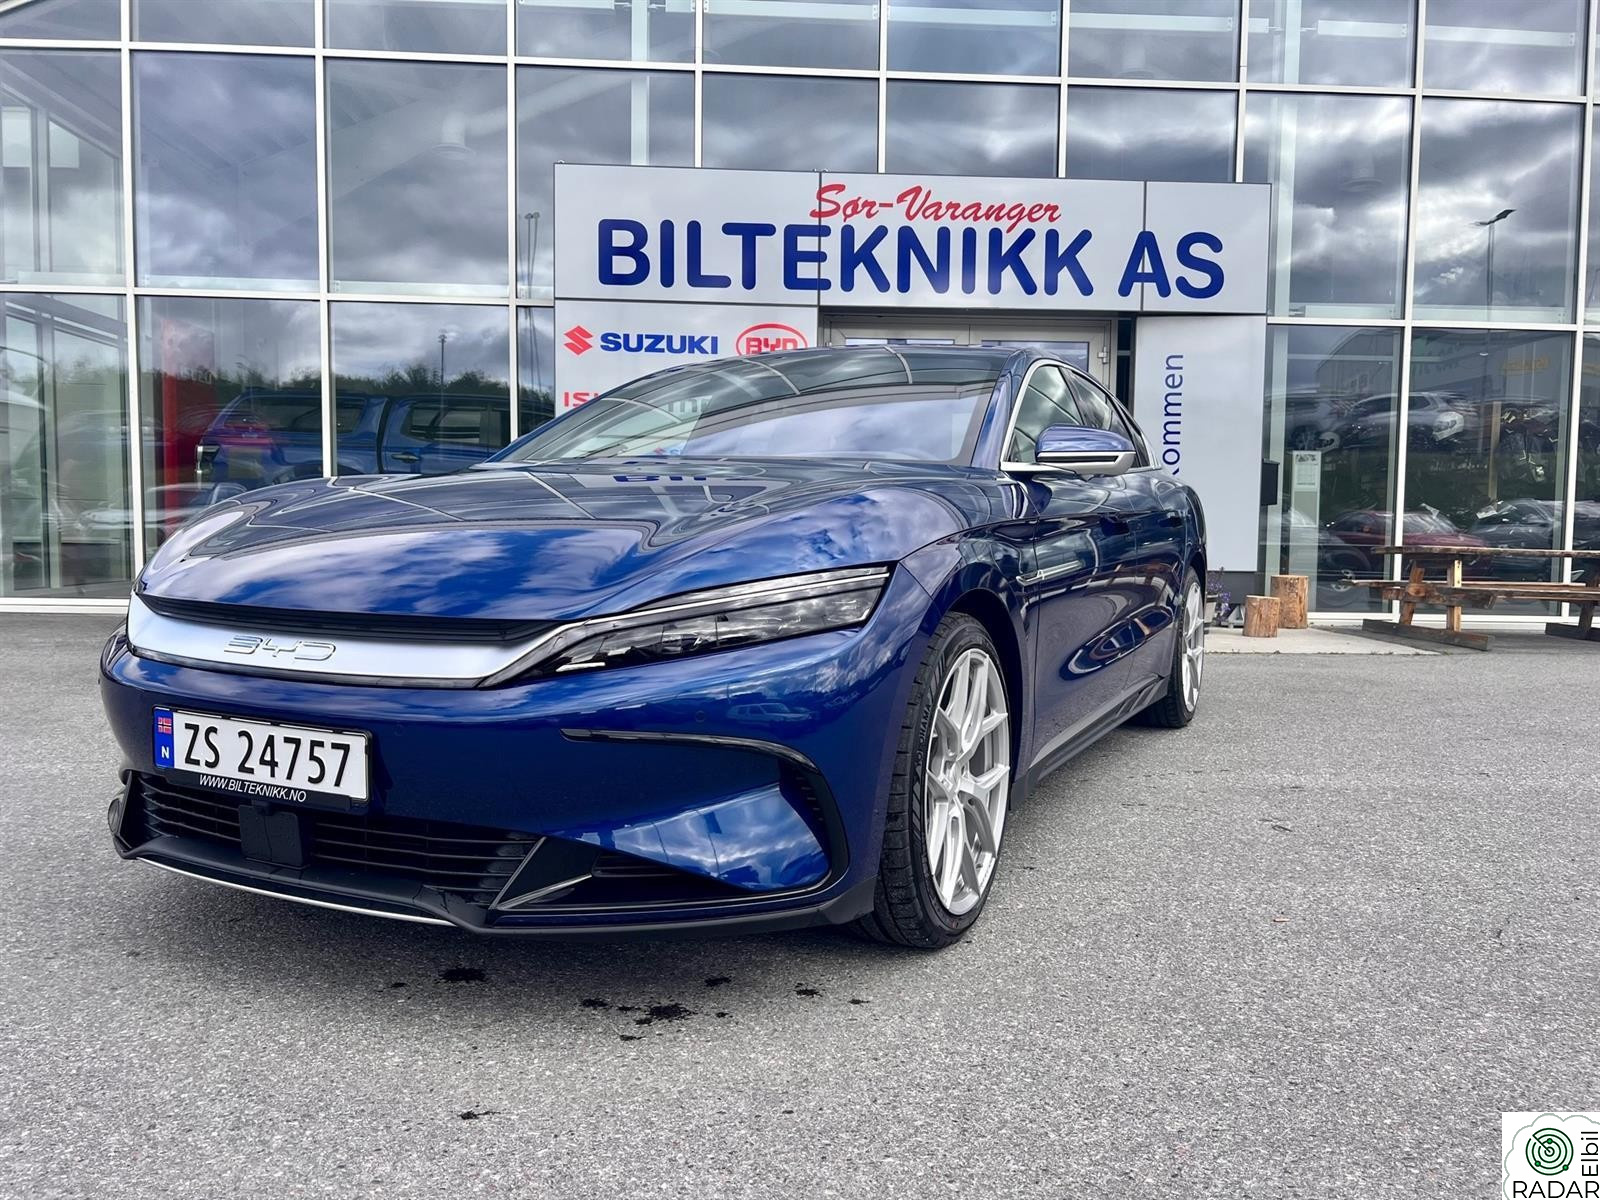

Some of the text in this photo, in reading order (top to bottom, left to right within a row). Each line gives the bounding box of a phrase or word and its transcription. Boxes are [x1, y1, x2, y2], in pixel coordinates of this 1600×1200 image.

[809, 183, 1062, 234] Sør-Varanger
[598, 219, 1225, 299] BILTEKNIKK AS
[600, 332, 719, 355] SUZUKI
[1162, 353, 1184, 476] ommen
[223, 634, 337, 661] BYD
[161, 745, 170, 759] N
[184, 722, 350, 787] ZS 24757
[200, 773, 307, 803] WWW.BILTEKNIKK.NO
